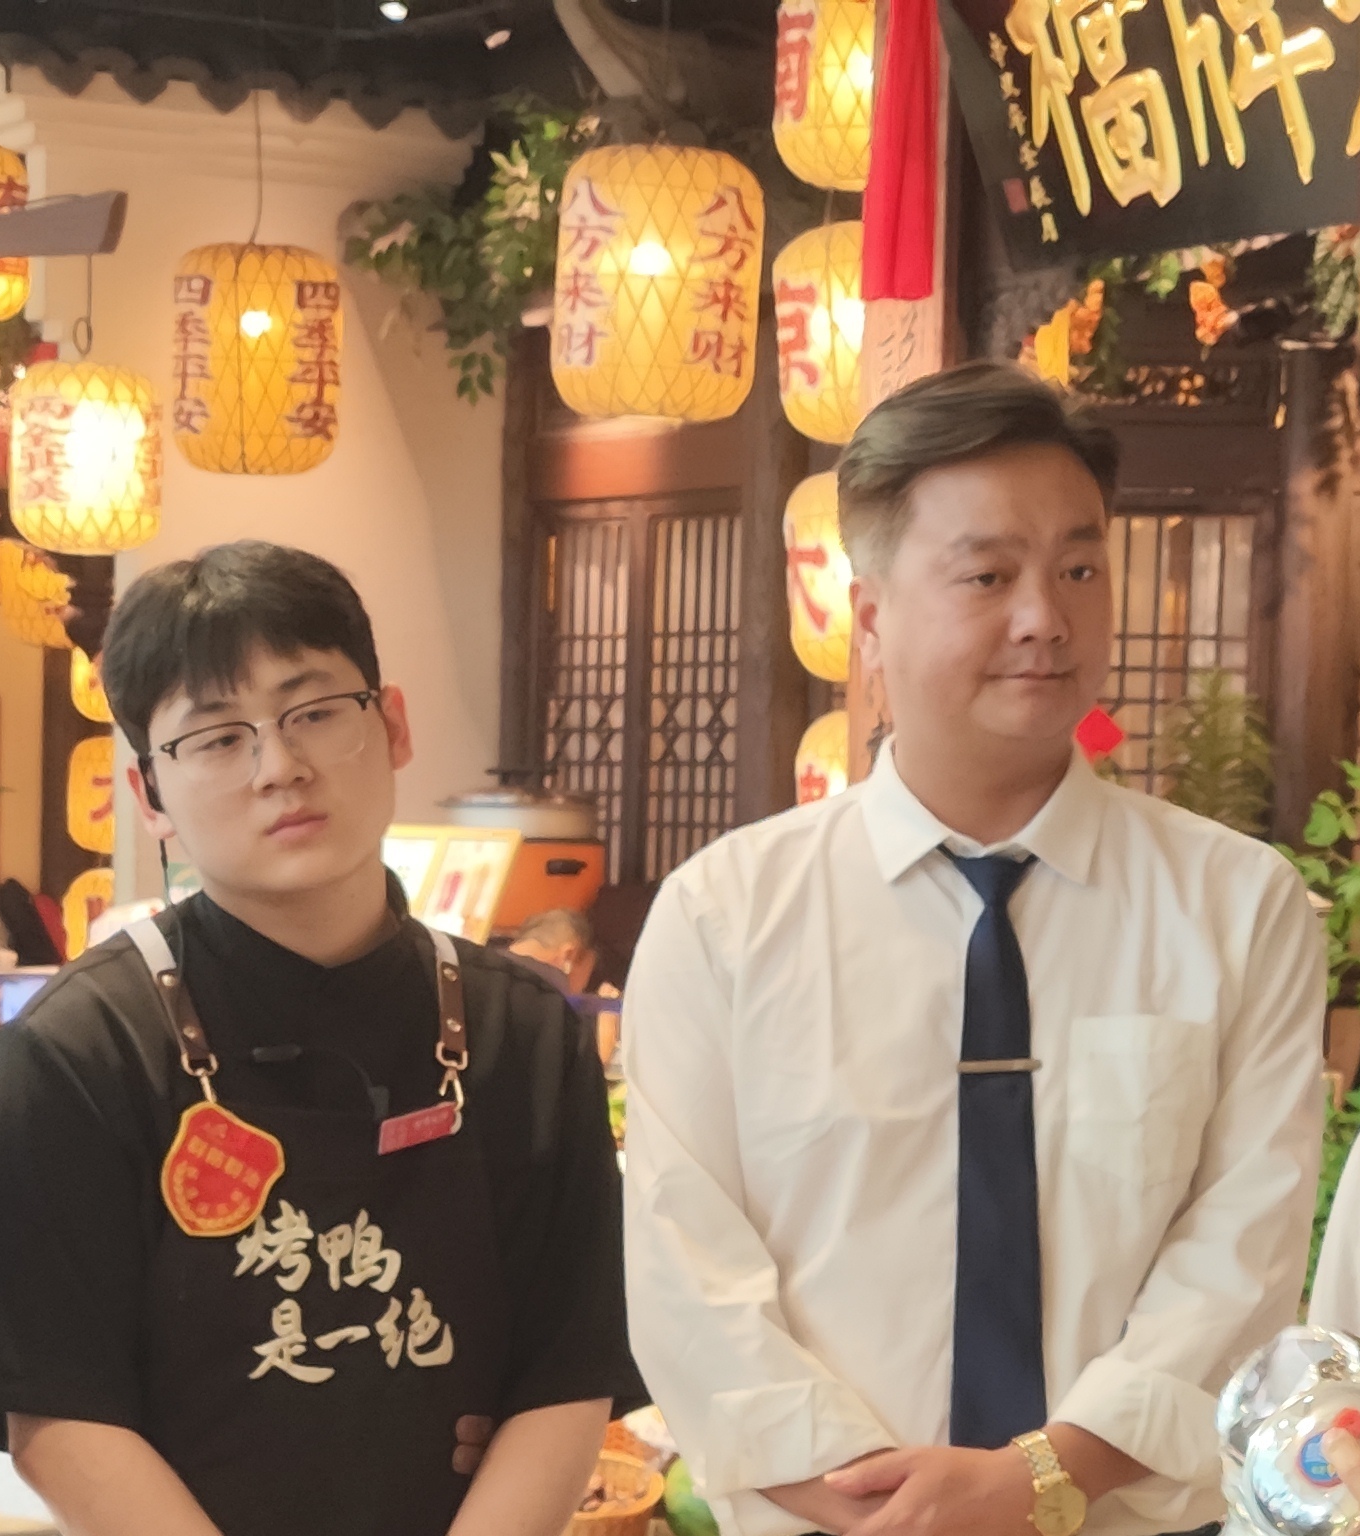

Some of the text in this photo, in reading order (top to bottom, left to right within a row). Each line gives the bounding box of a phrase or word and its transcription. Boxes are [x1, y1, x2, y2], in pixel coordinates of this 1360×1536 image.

[557, 176, 621, 370] 八方来财
[687, 185, 757, 381] 八方来财
[172, 274, 211, 434] 四季平安
[290, 279, 342, 440] 四季平安
[234, 1199, 403, 1294] 烤鸭
[248, 1286, 454, 1384] 是一绝
